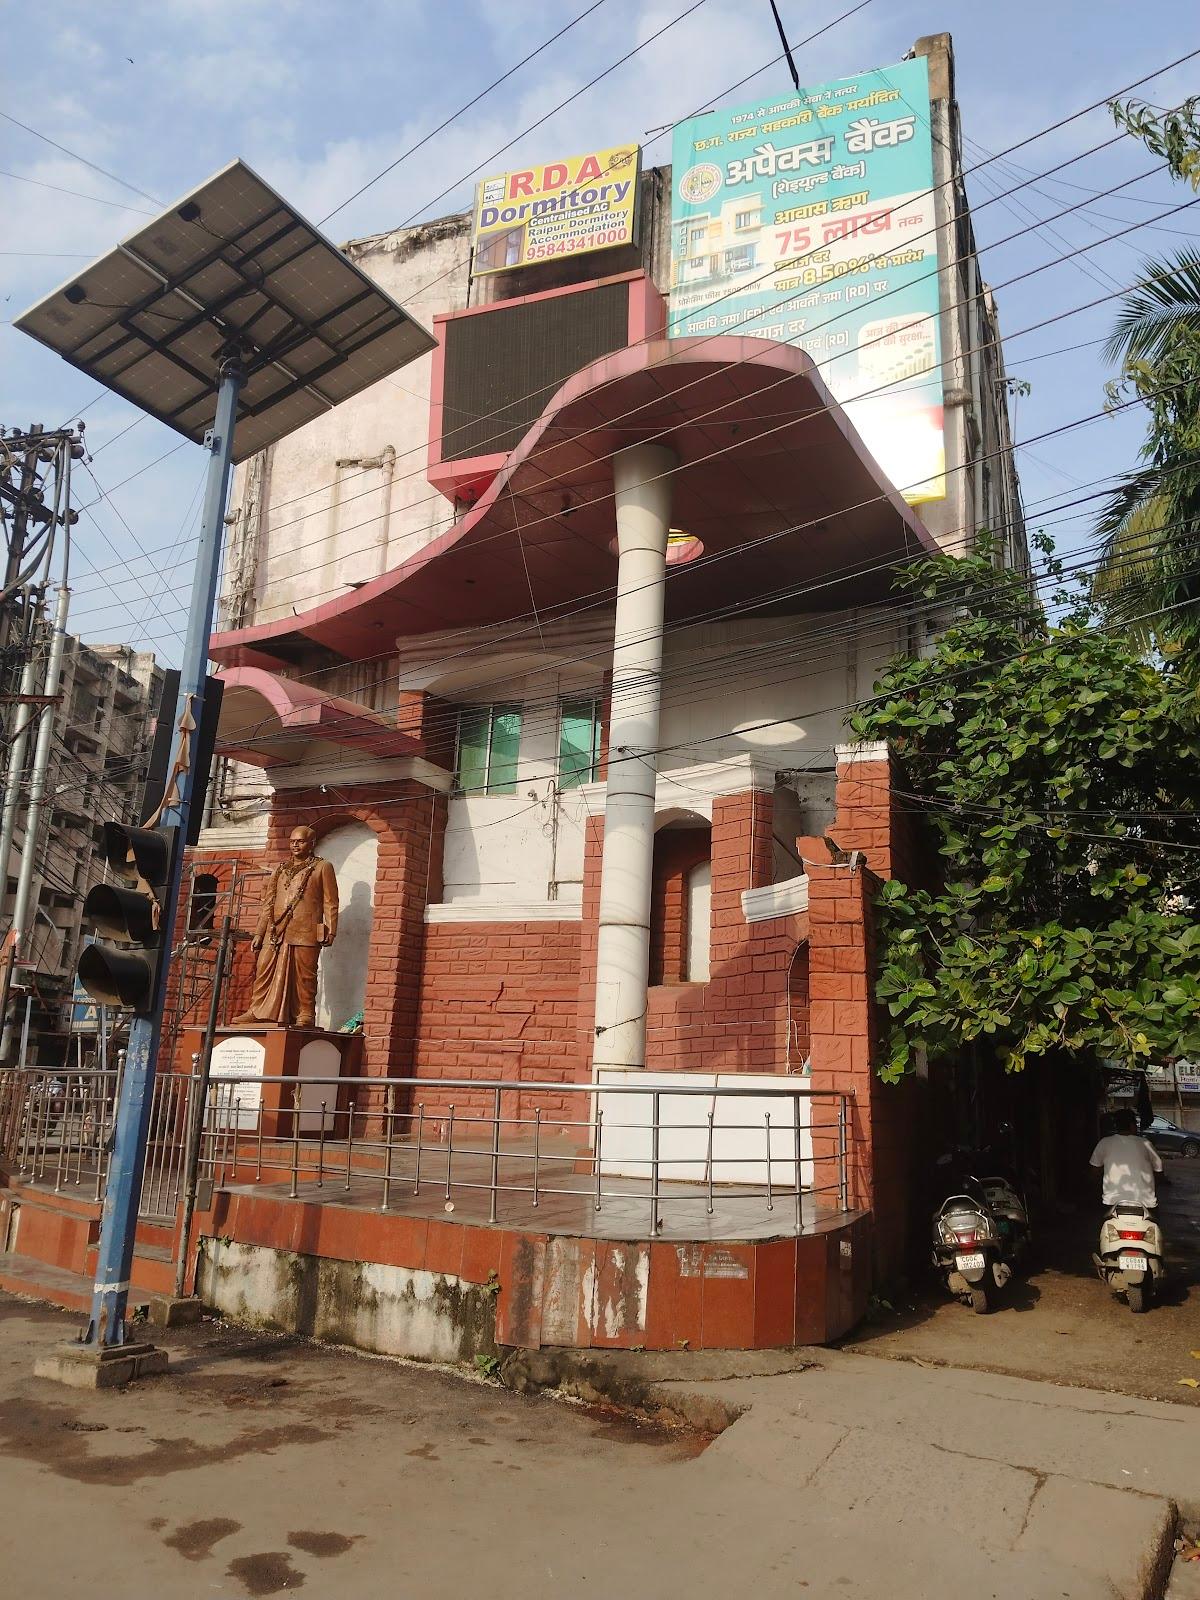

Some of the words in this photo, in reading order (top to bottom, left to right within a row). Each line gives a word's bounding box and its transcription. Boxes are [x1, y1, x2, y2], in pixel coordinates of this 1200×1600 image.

[727, 126, 758, 143] राज्य
[760, 108, 813, 135] सहकारी
[816, 102, 844, 119] बैंक
[846, 87, 900, 112] मर्यादित
[731, 112, 755, 125] 1974
[756, 107, 766, 119] से
[802, 92, 823, 105] सेवा
[724, 136, 835, 186] अपैक्स
[843, 115, 916, 154] बैंक
[509, 155, 610, 200] R.D.A.
[831, 159, 866, 181] बैंक)
[480, 180, 631, 228] Dormitory
[530, 206, 590, 227] Centralised
[593, 202, 609, 214] AC
[774, 200, 828, 225] आवास
[830, 190, 870, 212] ऋण
[528, 221, 565, 238] Raipur
[569, 209, 629, 229] Dormitory
[529, 219, 625, 246] Accommodation
[775, 226, 811, 256] 75
[821, 207, 894, 245] लाख
[897, 214, 924, 228] तक
[526, 228, 628, 261] 9584341000
[811, 250, 831, 264] दर
[774, 276, 801, 292] मात्र
[874, 256, 889, 270] से
[889, 249, 925, 268] प्रारंभ
[687, 315, 717, 335] सावधि
[719, 311, 741, 327] जमा
[821, 289, 841, 304] जमा
[844, 283, 870, 301] (RD)
[872, 279, 889, 292] पर
[788, 318, 808, 332] दर
[824, 329, 849, 350] (RD)
